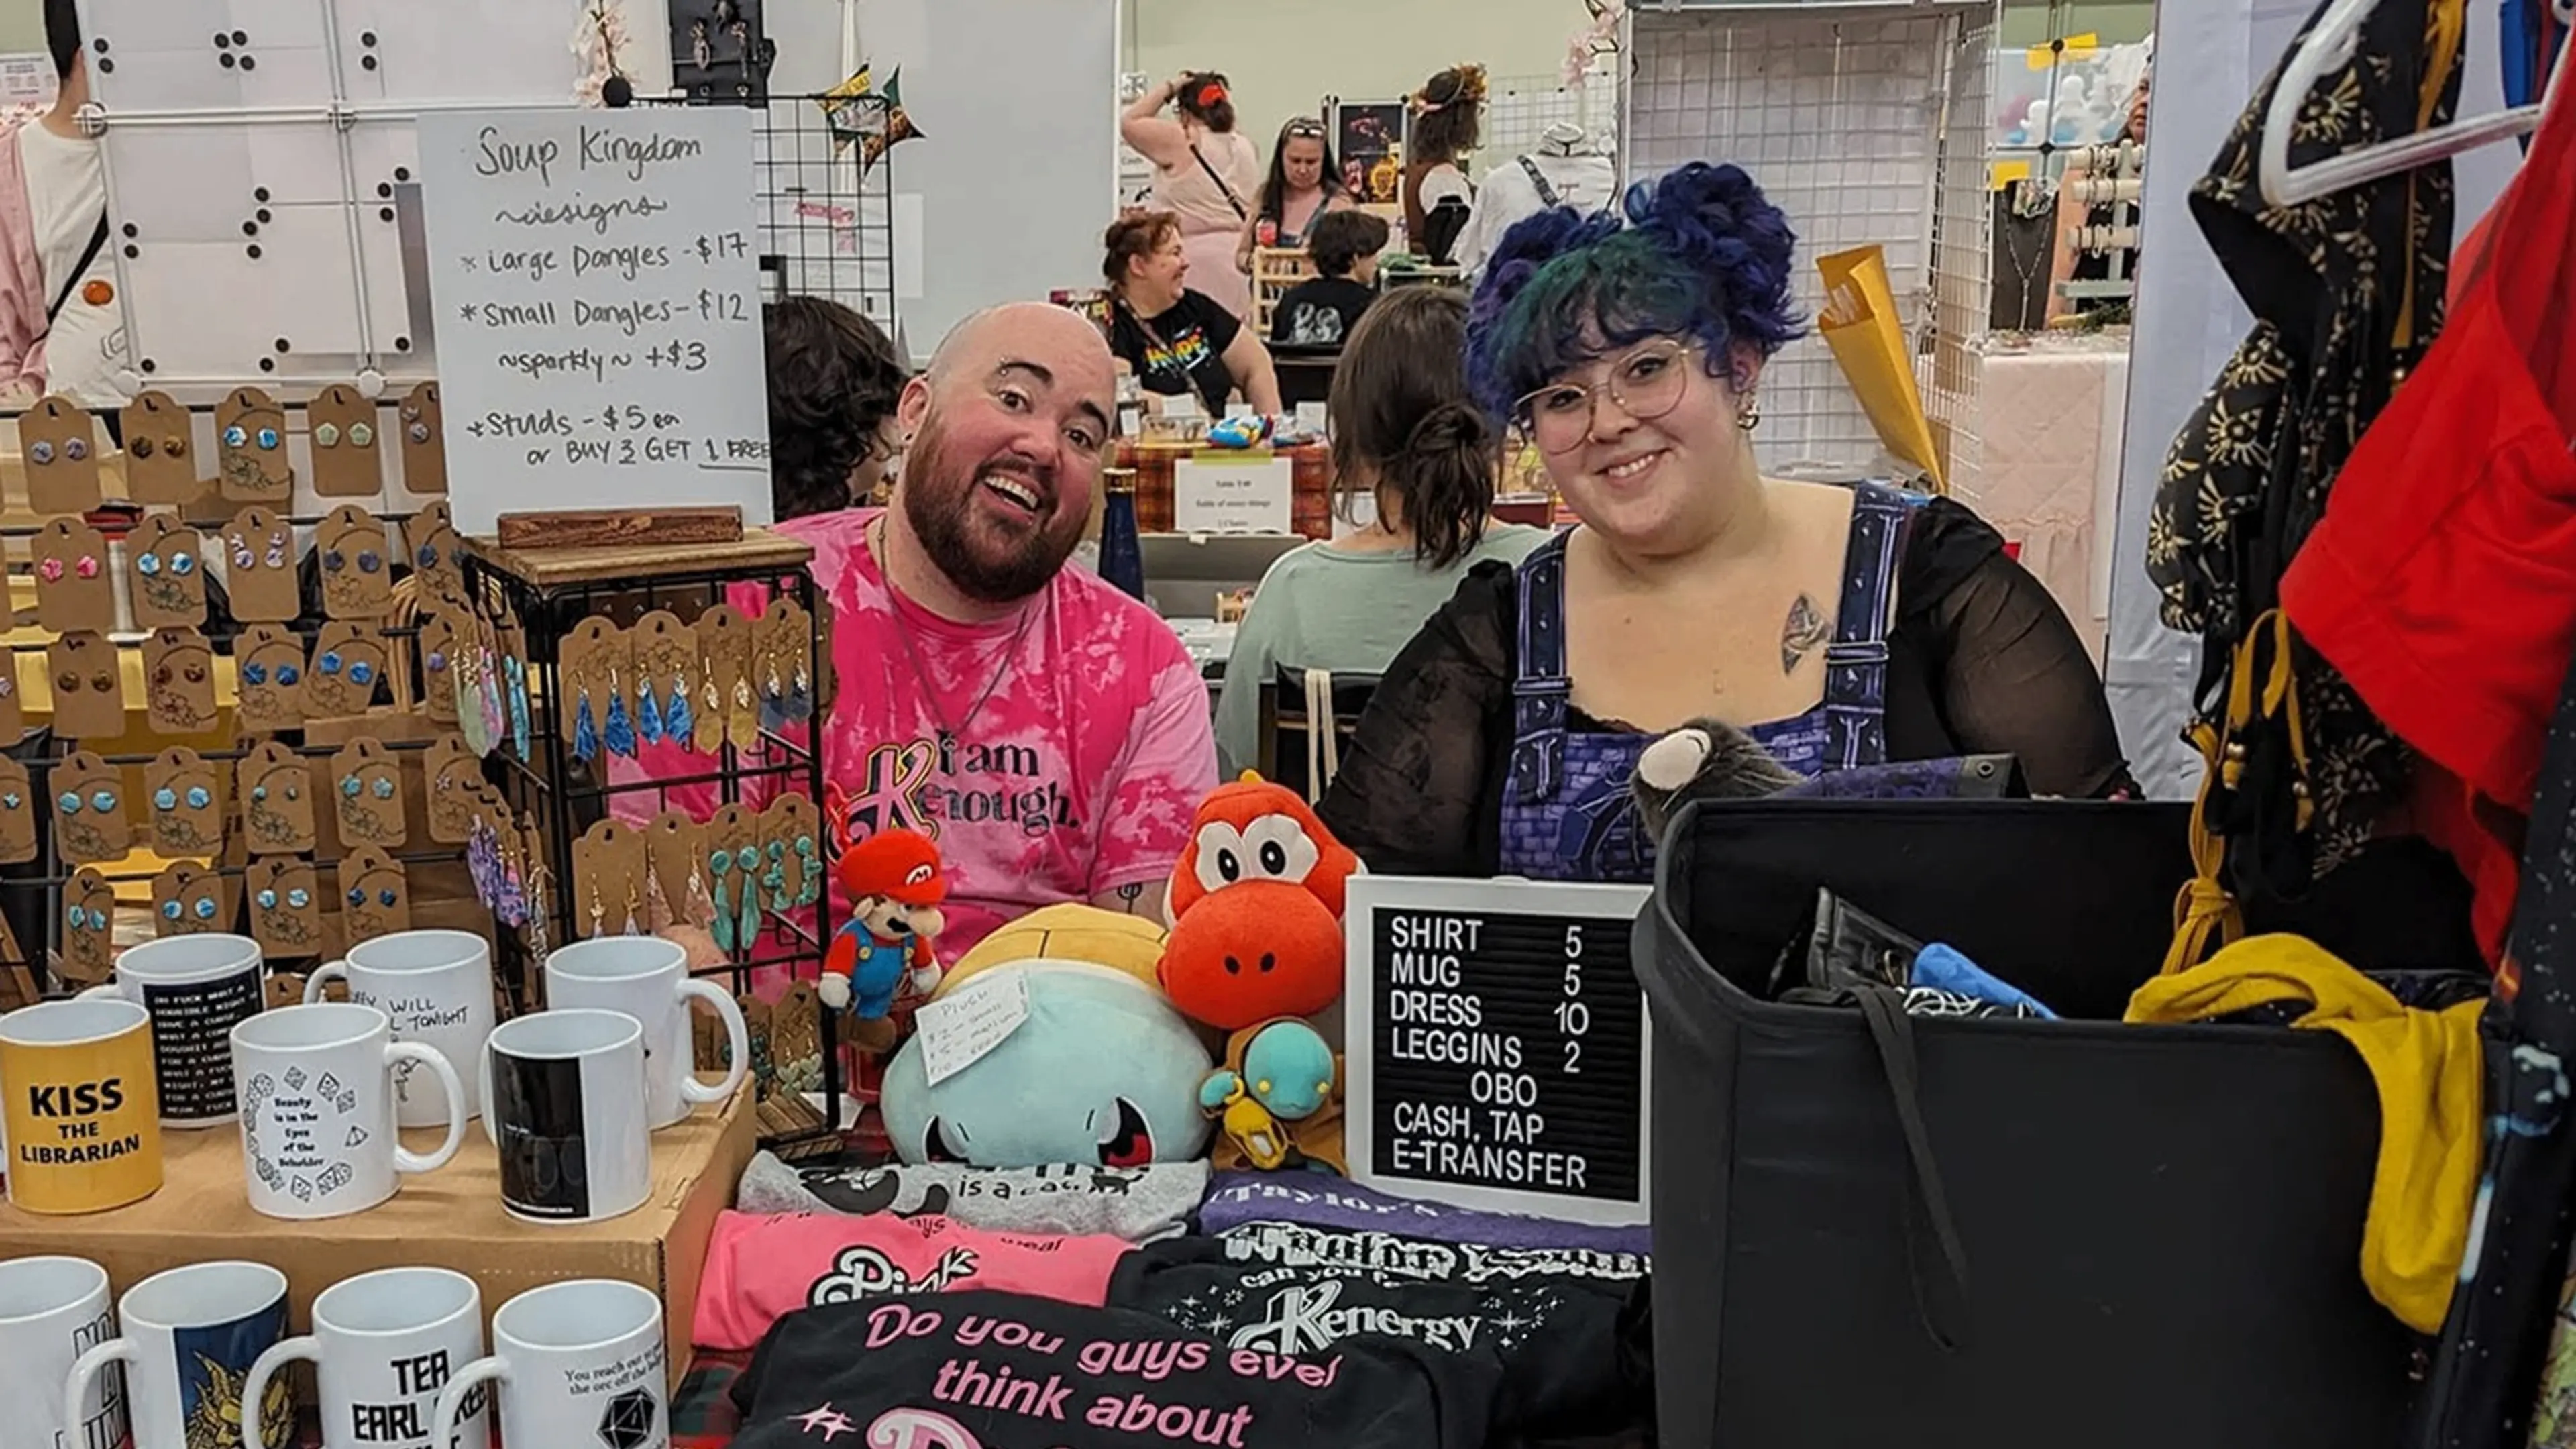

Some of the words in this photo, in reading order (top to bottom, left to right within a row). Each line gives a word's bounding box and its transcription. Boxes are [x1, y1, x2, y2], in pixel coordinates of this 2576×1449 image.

[475, 126, 559, 186] Soup
[580, 125, 702, 181] Kingdom
[574, 244, 670, 280] Dangles
[484, 302, 556, 328] Small
[486, 409, 574, 437] Studs
[644, 437, 692, 462] GET
[727, 439, 770, 460] FREE
[965, 743, 1039, 777] am
[1390, 916, 1483, 951] SHIRT
[1564, 925, 1582, 958] 5
[1391, 951, 1462, 987] MUG
[1564, 963, 1582, 996] 5
[388, 998, 436, 1013] WILL
[407, 1005, 468, 1032] TONIGHT
[1389, 990, 1482, 1027] DRESS
[1554, 1001, 1590, 1036] 10
[1391, 1026, 1522, 1069] LEGGINS
[1563, 1040, 1581, 1073] 2
[30, 1078, 123, 1117] KISS
[1470, 1071, 1537, 1108] OBO
[58, 1122, 99, 1140] THE
[1489, 1110, 1544, 1145] TAP
[20, 1133, 140, 1164] LIBRARIAN
[1393, 1139, 1586, 1189] E-TRANSFER
[959, 1175, 983, 1197] is
[993, 1181, 1011, 1199] a
[1240, 1267, 1297, 1288] can
[1227, 1279, 1481, 1355] Kenergy
[866, 1304, 942, 1350] Do
[955, 1316, 1066, 1354] you
[1076, 1340, 1210, 1381] guys
[391, 1349, 449, 1395] TEA
[564, 1369, 590, 1381] You
[933, 1358, 1074, 1420] think
[1086, 1394, 1253, 1448] about
[352, 1403, 429, 1441] EARL
